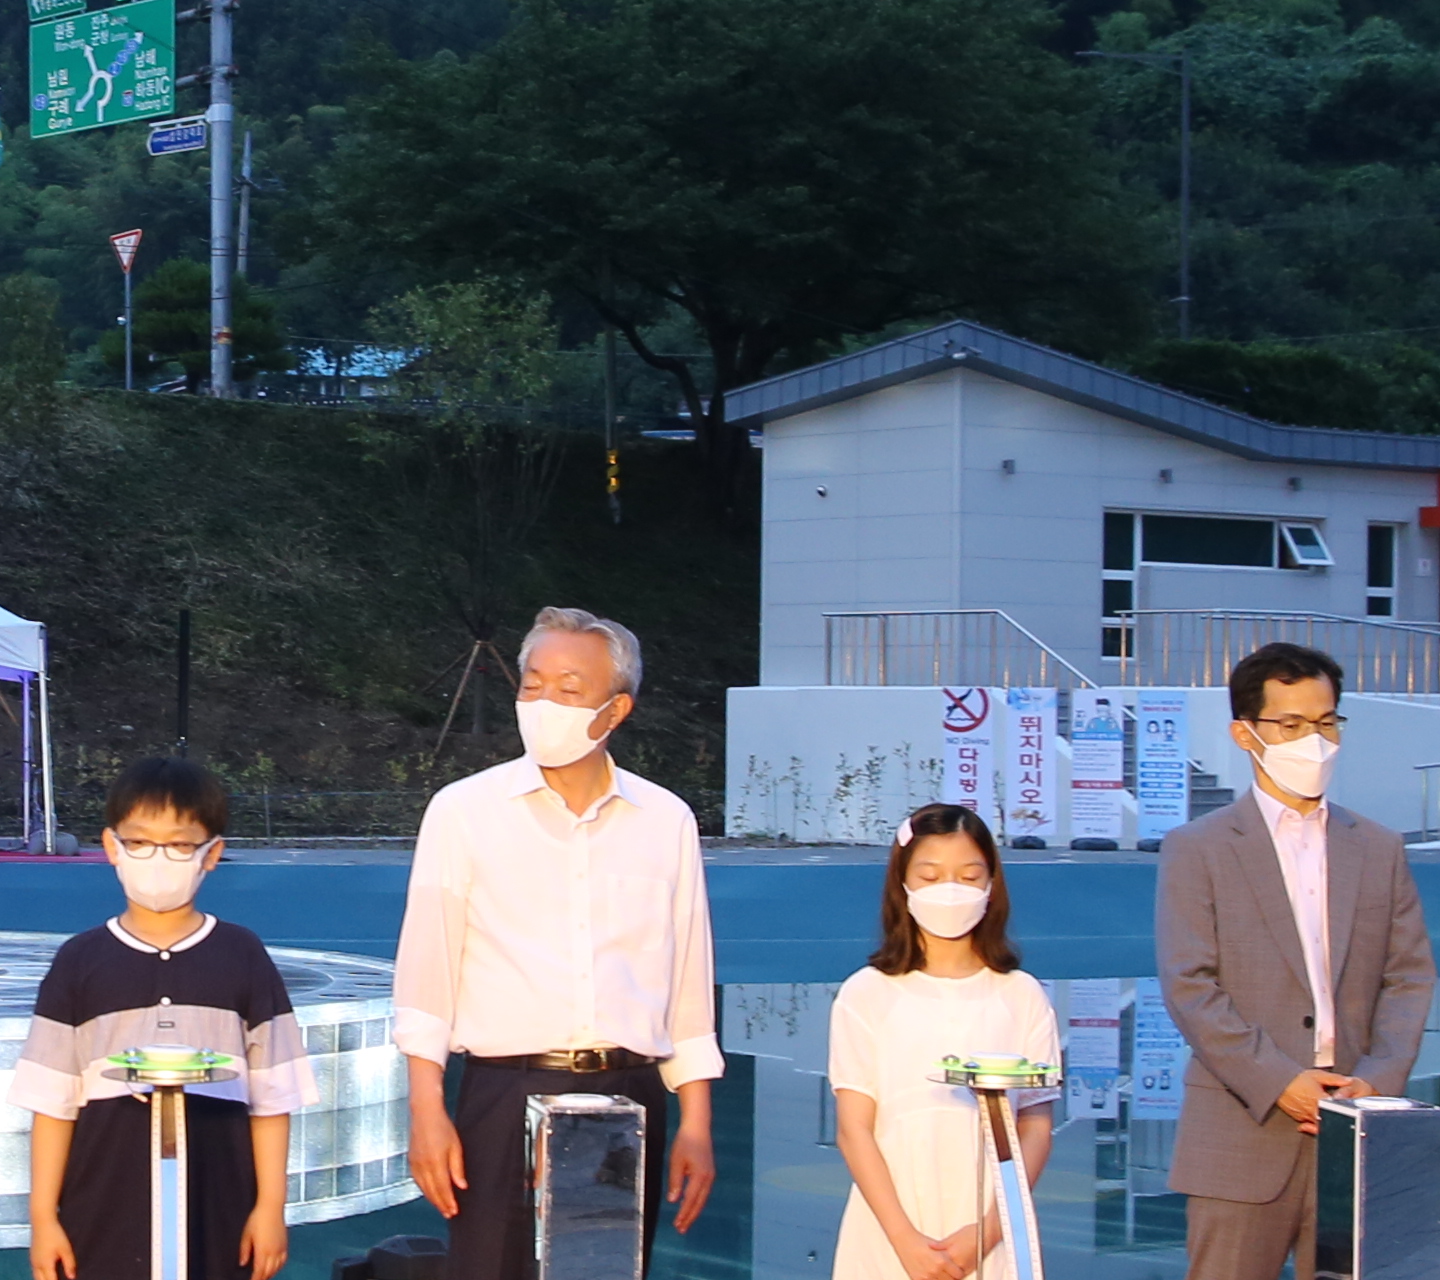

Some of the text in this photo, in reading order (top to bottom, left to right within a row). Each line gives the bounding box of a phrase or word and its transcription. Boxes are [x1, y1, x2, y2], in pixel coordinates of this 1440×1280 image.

[135, 48, 156, 68] 남해
[946, 737, 959, 745] NO
[1018, 716, 1043, 804] 뛰지마시오
